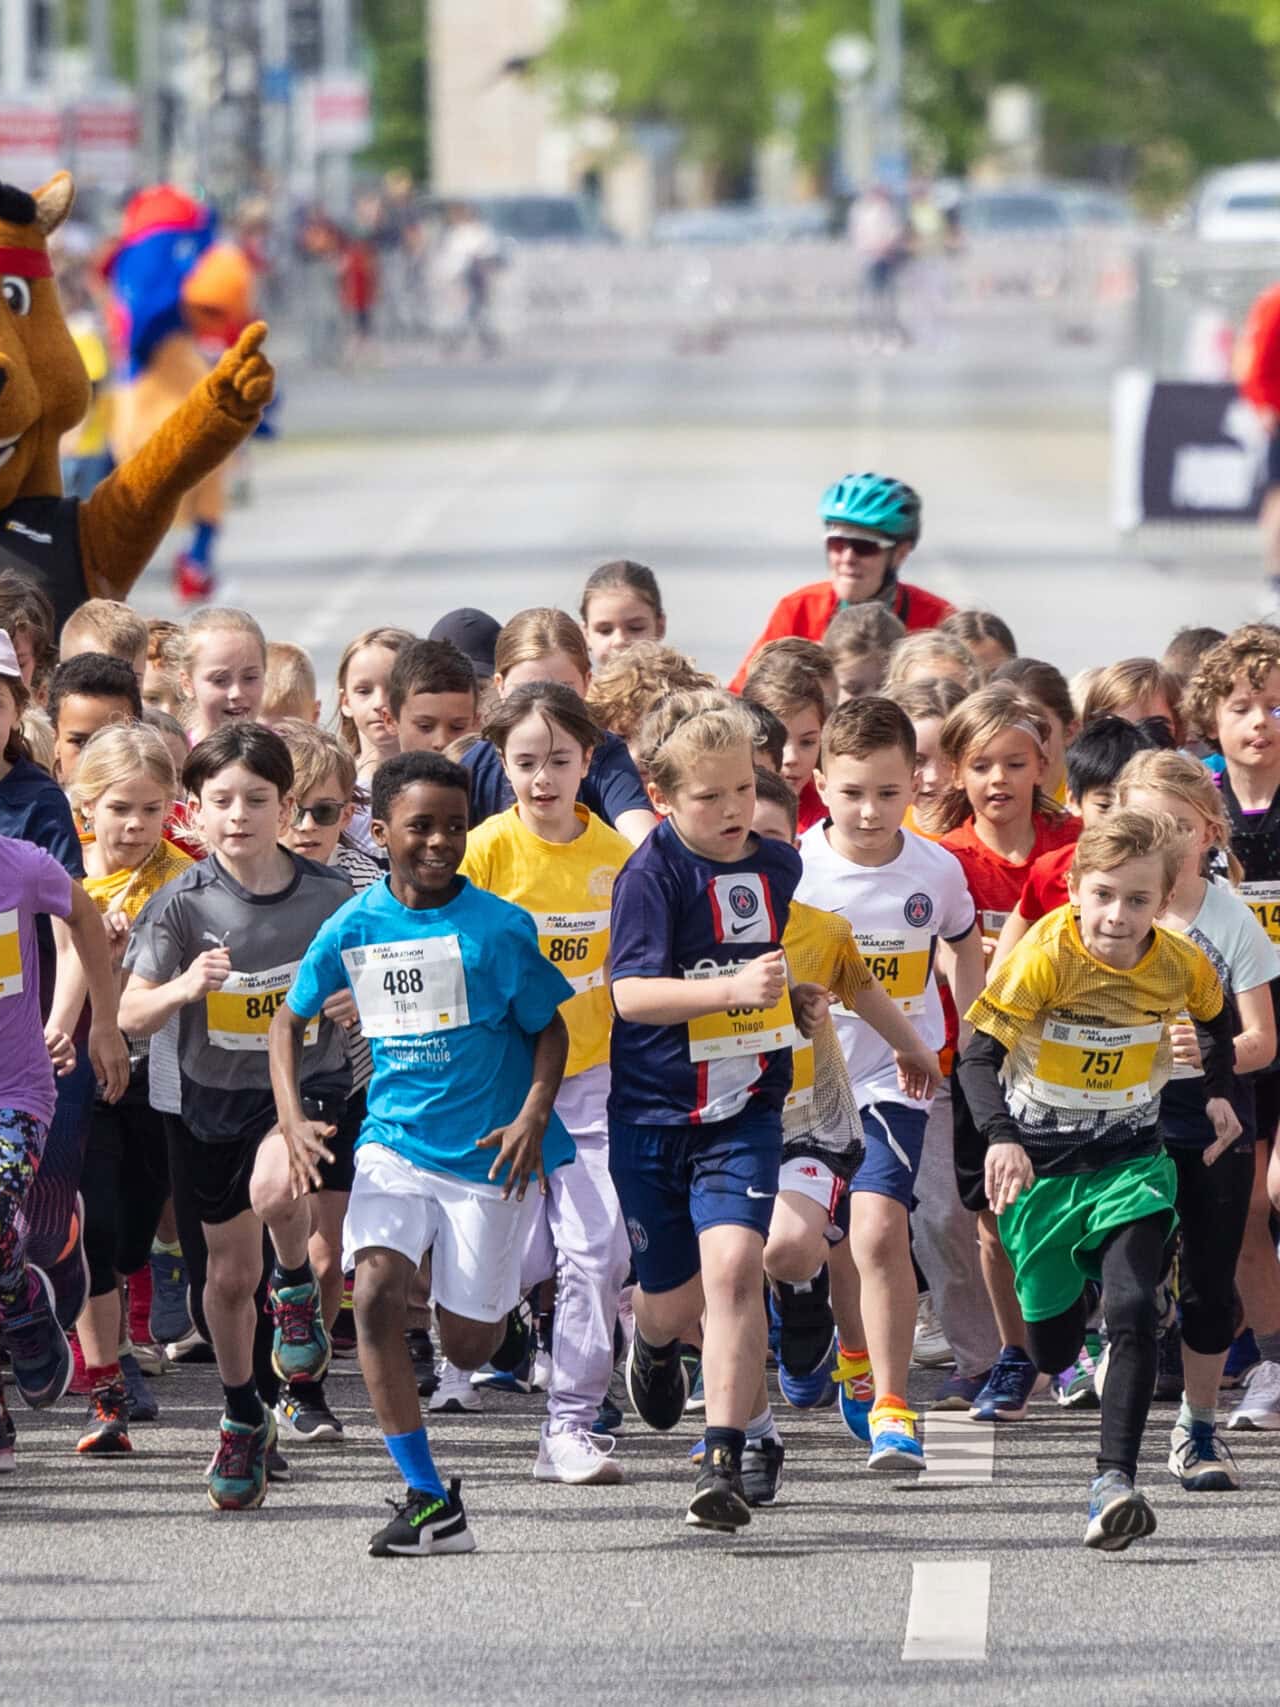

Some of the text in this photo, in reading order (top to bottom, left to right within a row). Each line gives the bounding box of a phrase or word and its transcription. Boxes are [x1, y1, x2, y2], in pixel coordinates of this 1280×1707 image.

[554, 920, 597, 929] MARATHON
[549, 937, 589, 962] 866
[246, 972, 292, 988] MARATHON
[383, 968, 424, 995] 488
[732, 1021, 765, 1034] Thiago
[1086, 1033, 1133, 1044] MARATHON
[1080, 1050, 1124, 1076] 757
